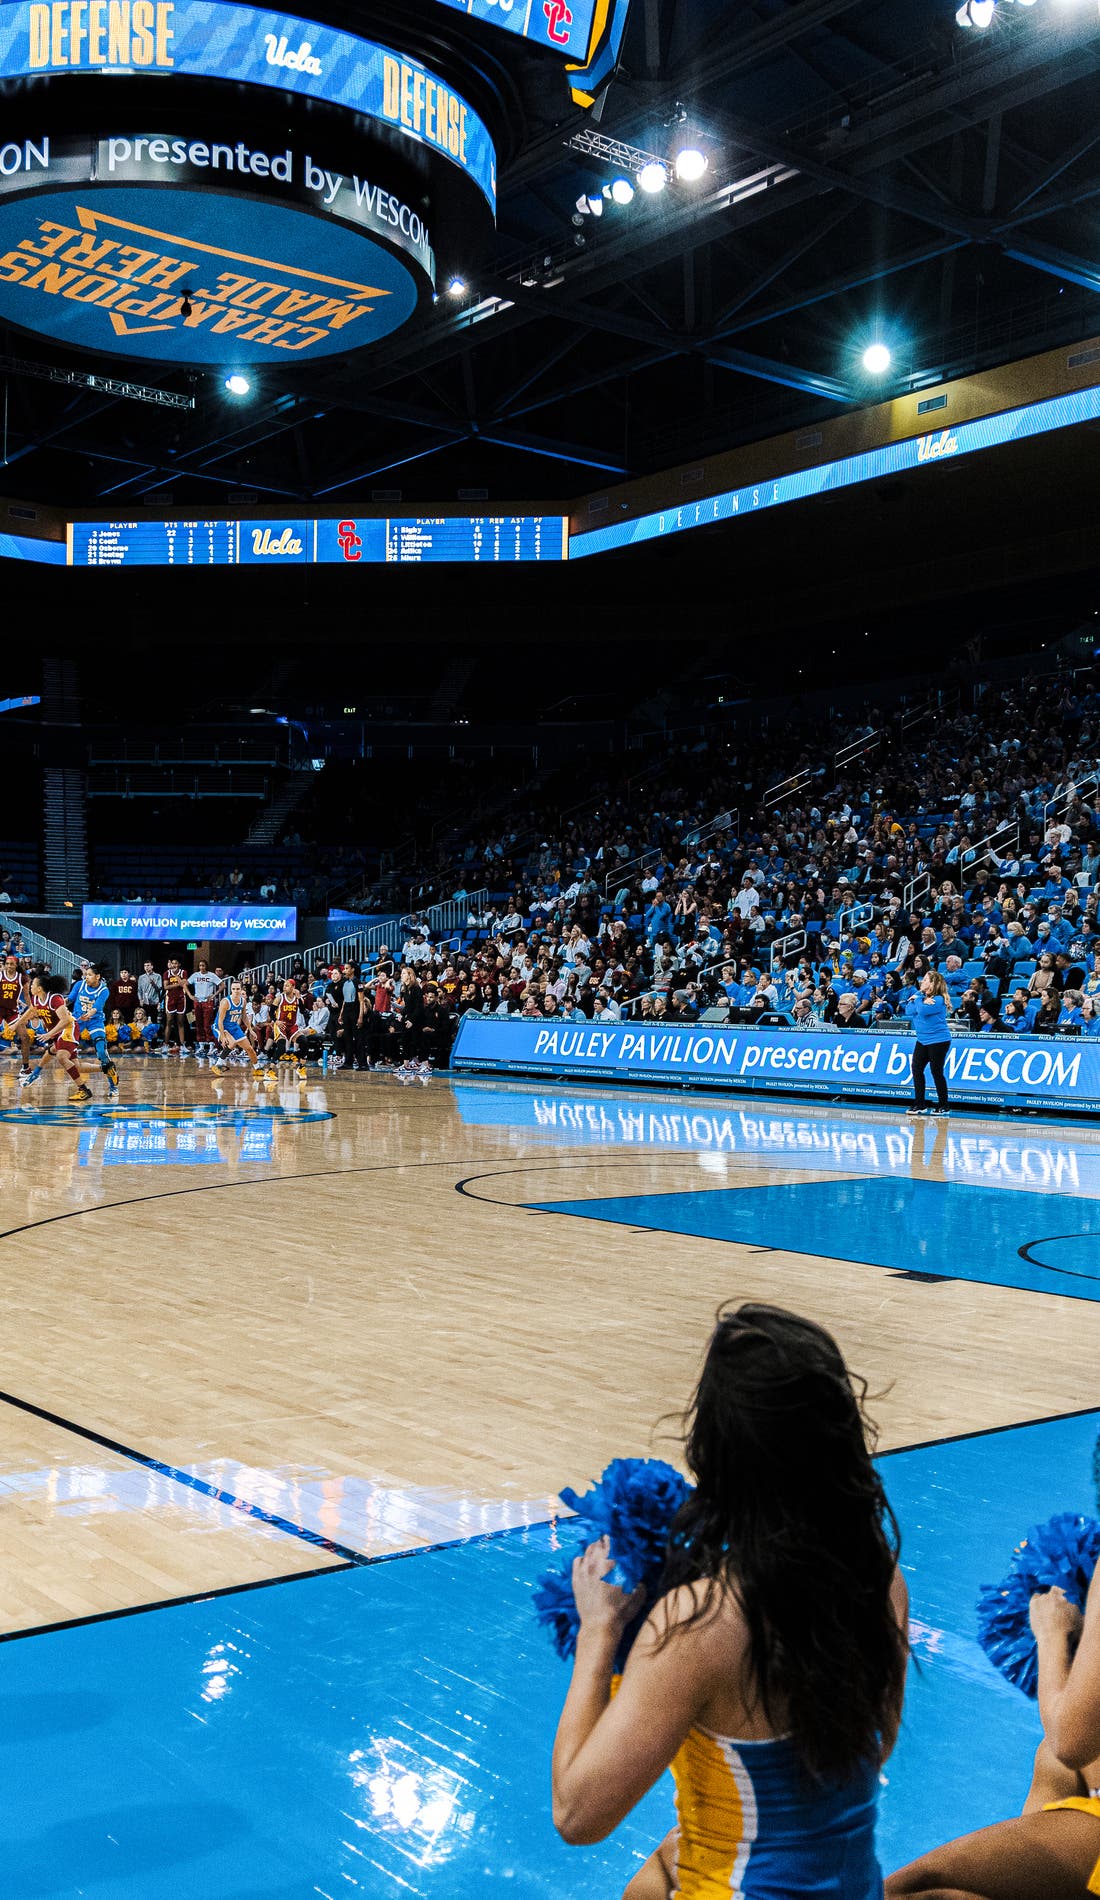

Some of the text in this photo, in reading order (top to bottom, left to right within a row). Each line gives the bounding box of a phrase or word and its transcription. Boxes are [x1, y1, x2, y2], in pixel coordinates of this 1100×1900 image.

[29, 0, 175, 68] DEFENSE
[383, 55, 467, 165] DEFENSE
[108, 137, 292, 182] presented
[305, 155, 343, 204] by
[352, 174, 430, 250] WESCOM
[16, 220, 376, 330] MADE HERE
[0, 251, 330, 350] CHAMPIONS
[659, 483, 779, 531] DEFENSE
[252, 528, 303, 555] Ucla
[92, 918, 286, 931] PAULEY PAVILION presented by WESCOM
[118, 986, 132, 994] USC
[287, 1012, 292, 1020] 4
[533, 1030, 616, 1058] PAULEY
[618, 1033, 737, 1065] PAVILION
[740, 1042, 881, 1075] presented
